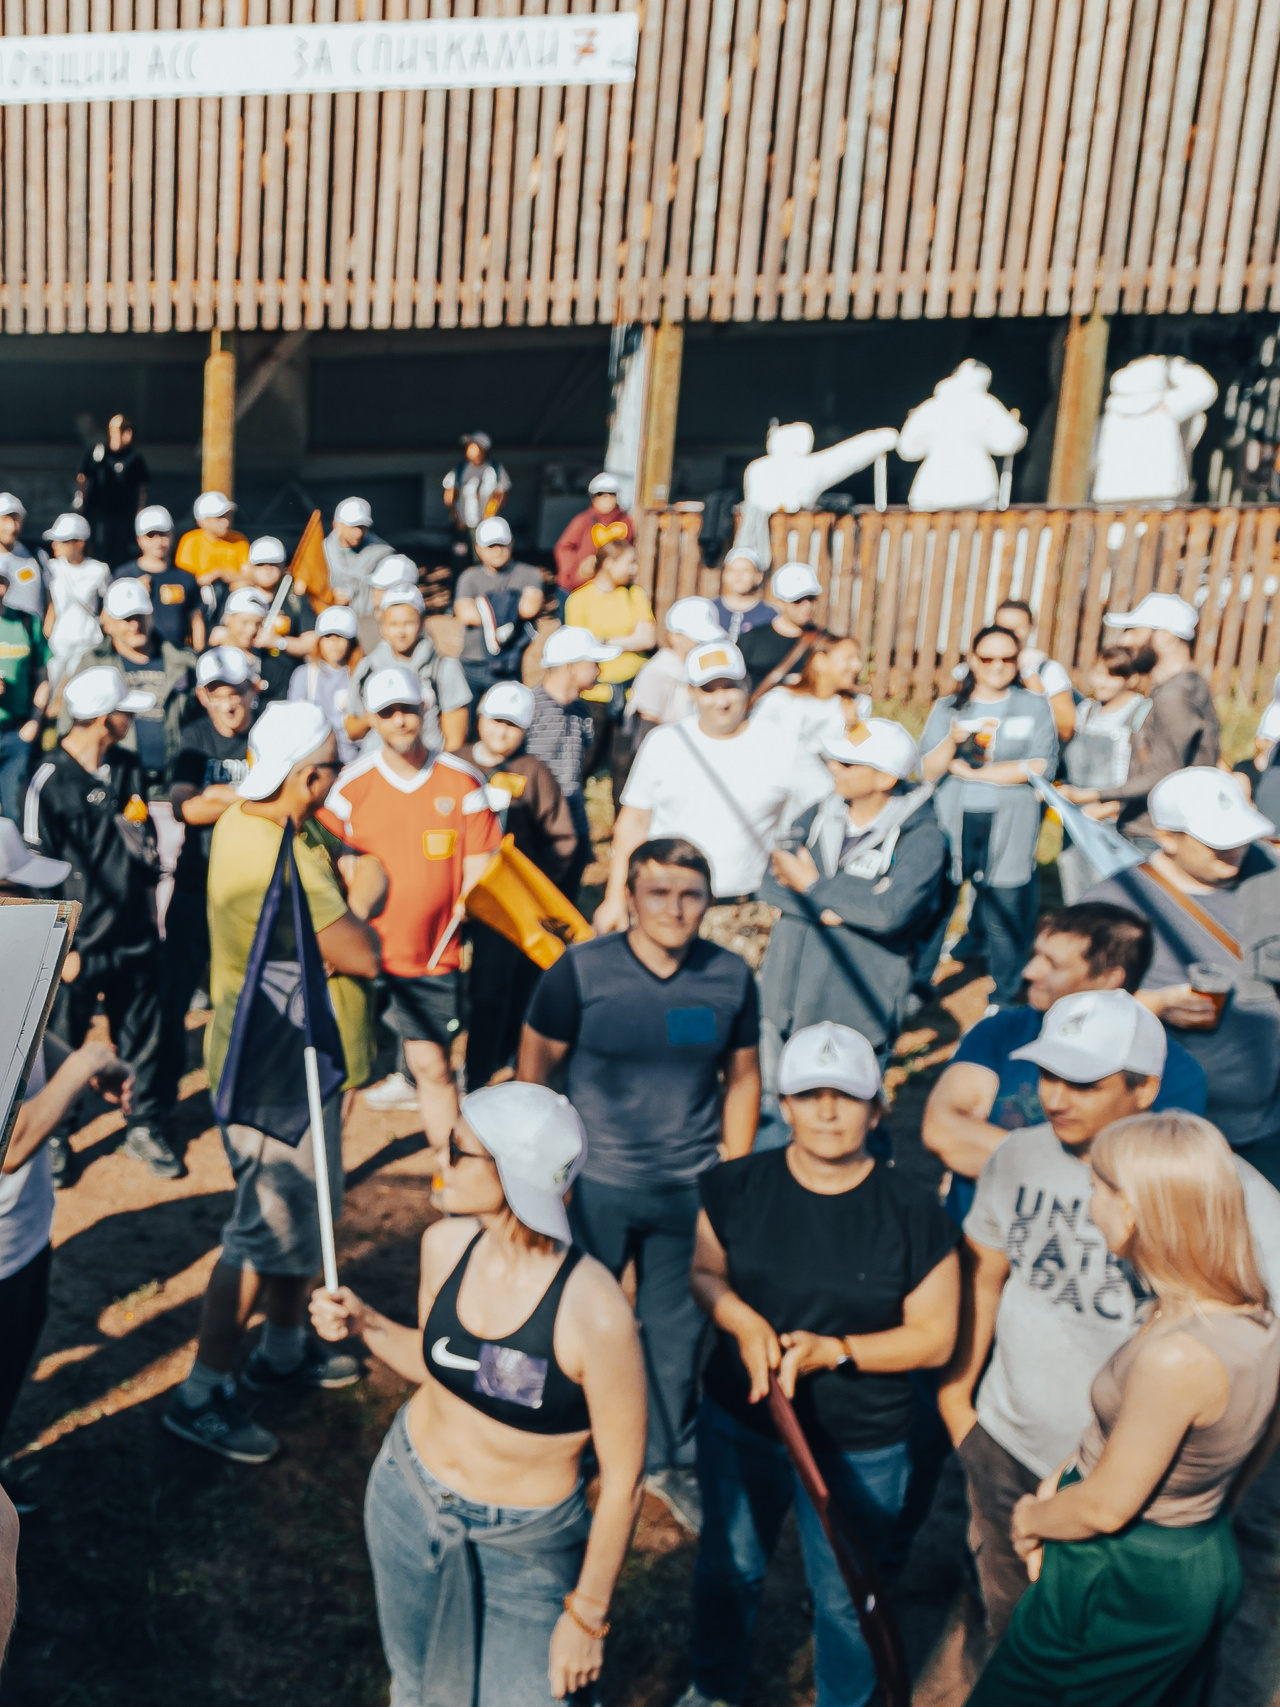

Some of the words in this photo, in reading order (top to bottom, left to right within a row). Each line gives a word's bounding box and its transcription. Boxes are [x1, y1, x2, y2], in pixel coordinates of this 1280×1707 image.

[147, 41, 201, 83] АСС
[291, 36, 333, 82] ЗА
[350, 28, 560, 77] СПИЧКАМИ
[574, 27, 597, 68] 7
